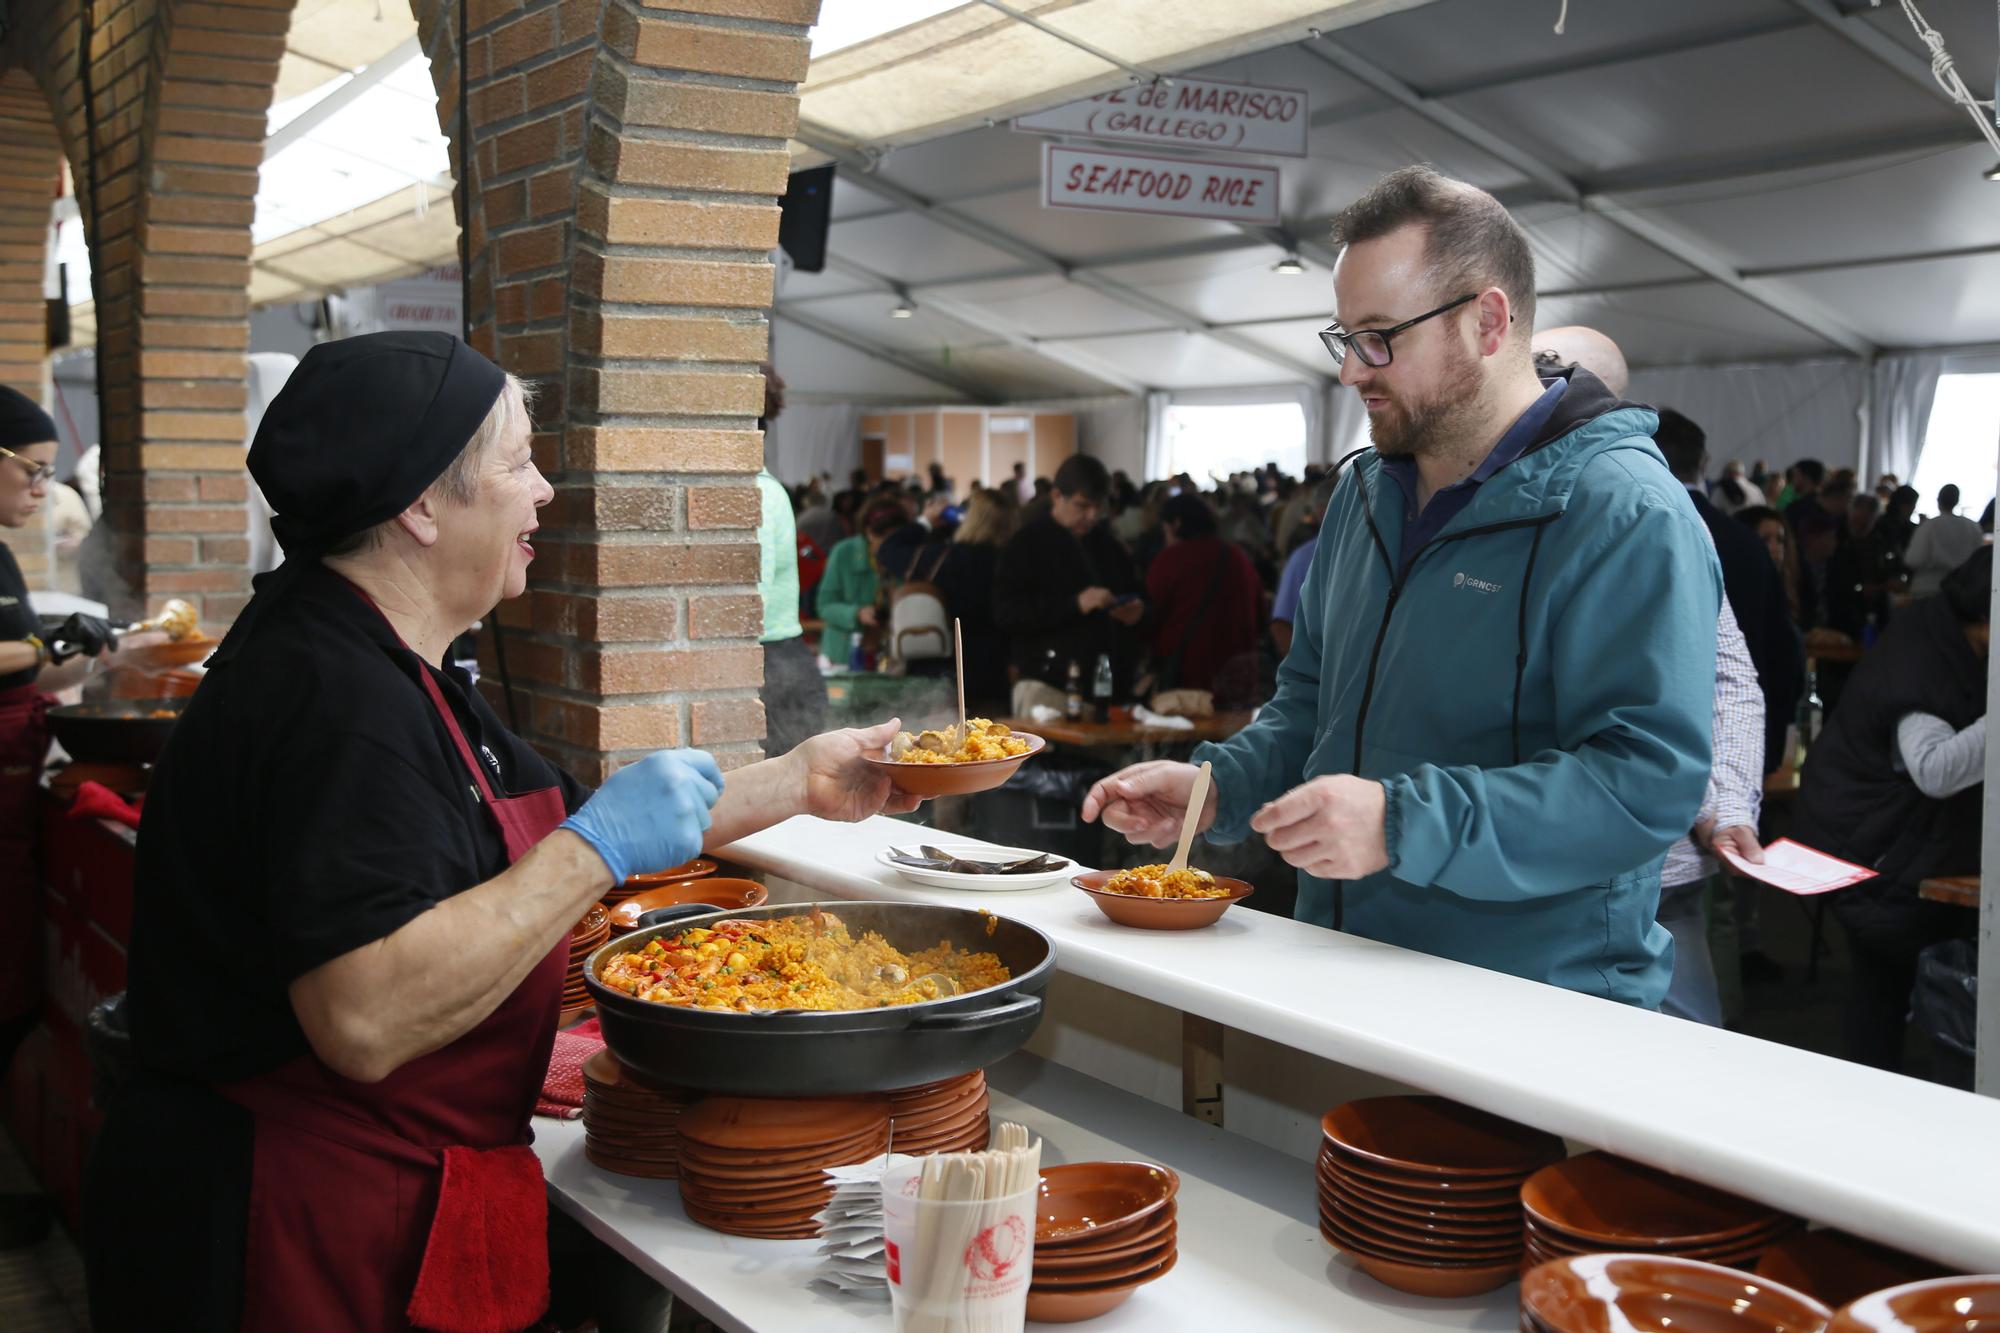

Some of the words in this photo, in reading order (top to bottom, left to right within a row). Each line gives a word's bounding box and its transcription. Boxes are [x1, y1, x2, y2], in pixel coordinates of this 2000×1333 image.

[1137, 79, 1168, 110] de
[1175, 86, 1299, 123] MARISCO
[1064, 163, 1193, 202] SEAFOOD
[1201, 176, 1264, 207] RICE
